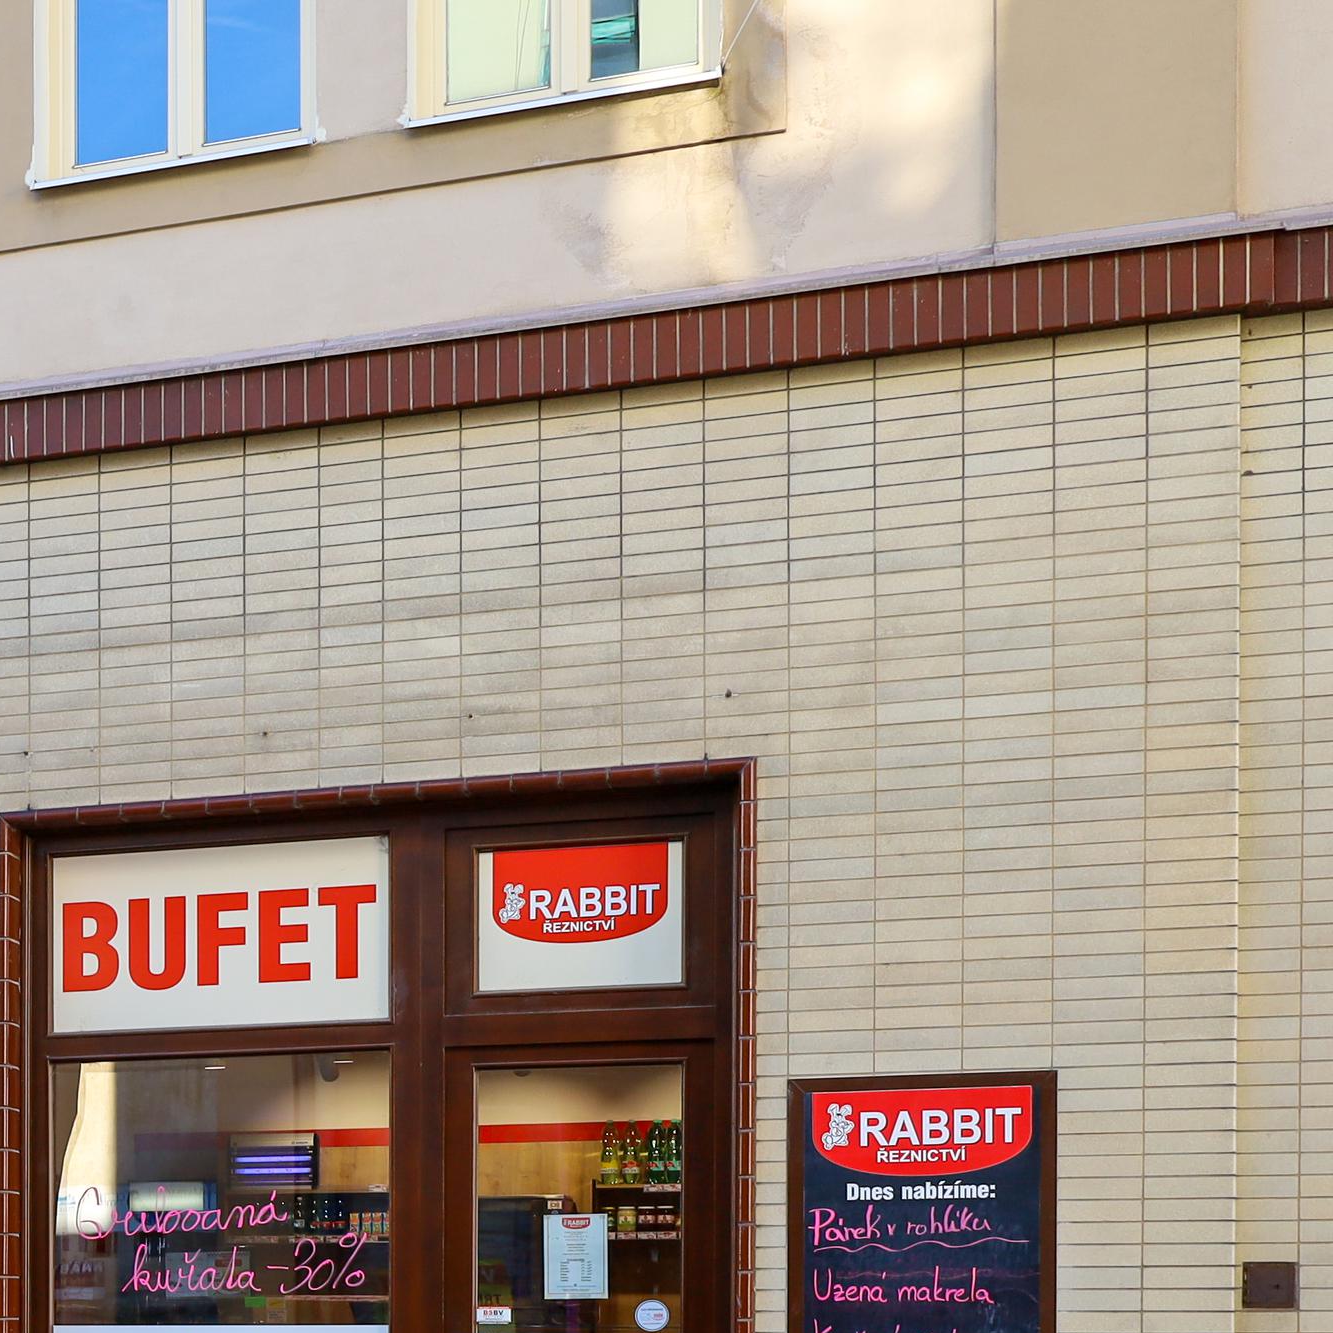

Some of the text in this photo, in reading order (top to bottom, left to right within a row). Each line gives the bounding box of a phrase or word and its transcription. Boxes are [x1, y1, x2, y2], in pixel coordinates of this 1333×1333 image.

[529, 882, 661, 919] RABBIT
[62, 883, 376, 993] BUFET
[542, 917, 616, 934] ŘEZNICTVÍ
[859, 1107, 1022, 1147] RABBIT
[876, 1146, 966, 1163] ŘEZNICTVÍ
[846, 1180, 996, 1201] Dnes nabízíme:
[808, 1204, 881, 1246] Párek
[122, 1243, 261, 1292] kuřata
[814, 1265, 995, 1304] Uzená makrela
